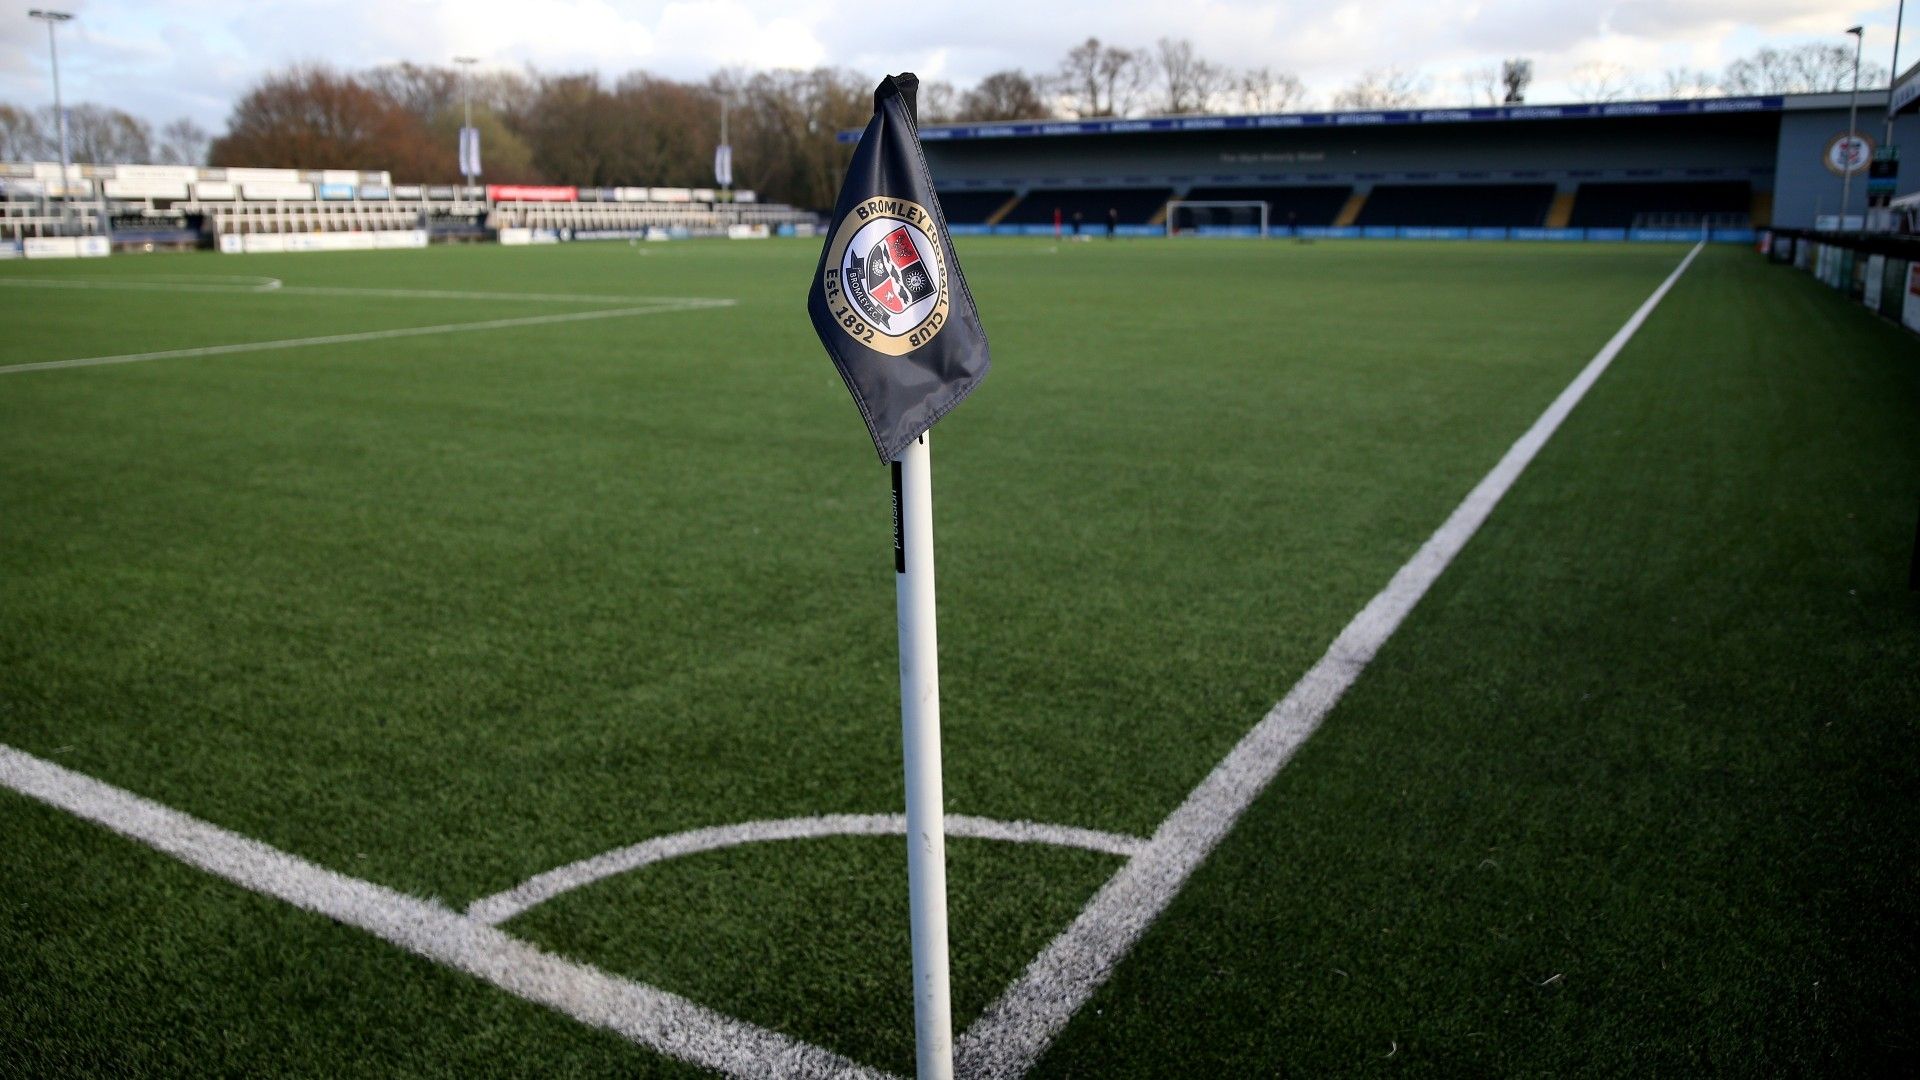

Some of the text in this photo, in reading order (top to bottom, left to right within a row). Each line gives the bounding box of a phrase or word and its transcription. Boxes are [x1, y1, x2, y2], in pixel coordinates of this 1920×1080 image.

[826, 268, 876, 344] Est. 1892
[856, 199, 948, 347] BROMLEY FOOTBALL CLUB
[891, 489, 901, 549] precision
